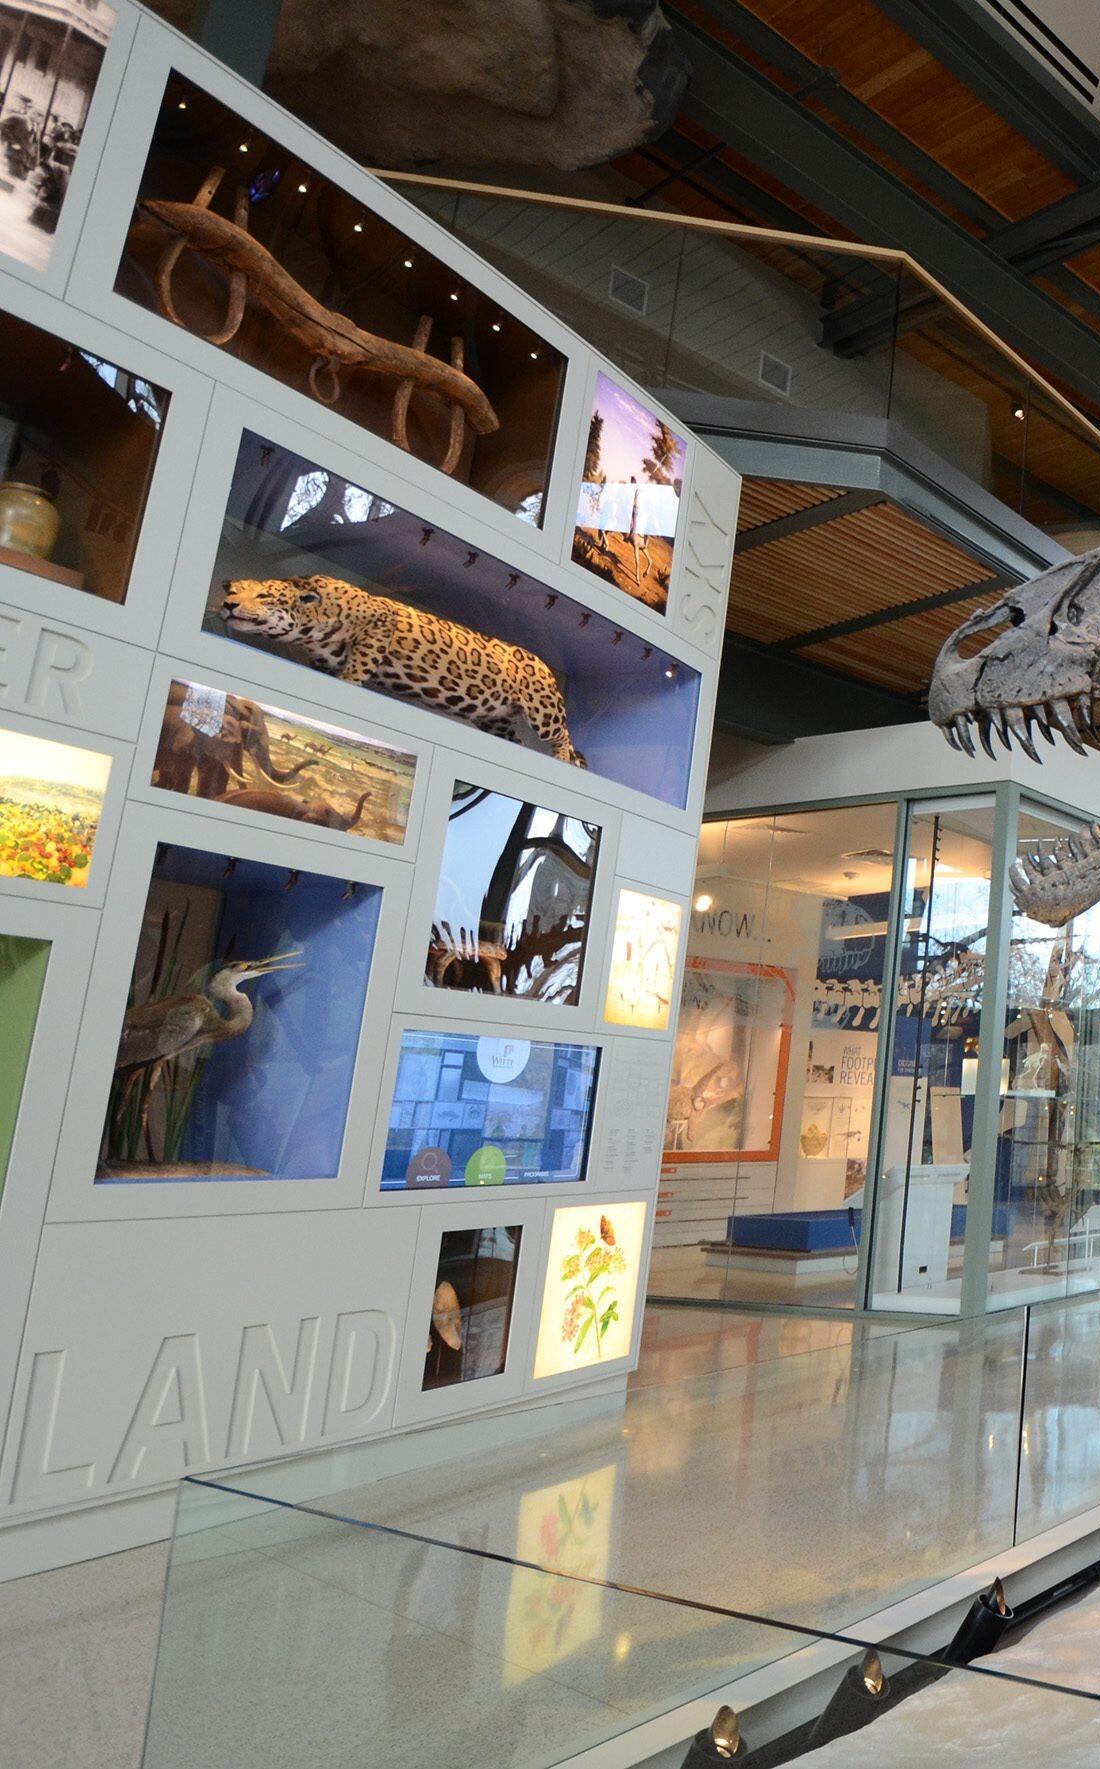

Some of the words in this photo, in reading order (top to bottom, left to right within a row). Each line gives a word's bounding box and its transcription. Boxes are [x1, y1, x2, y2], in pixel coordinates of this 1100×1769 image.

[680, 490, 729, 638] SKY
[843, 1046, 861, 1055] WHAT
[11, 1308, 396, 1504] LAND
